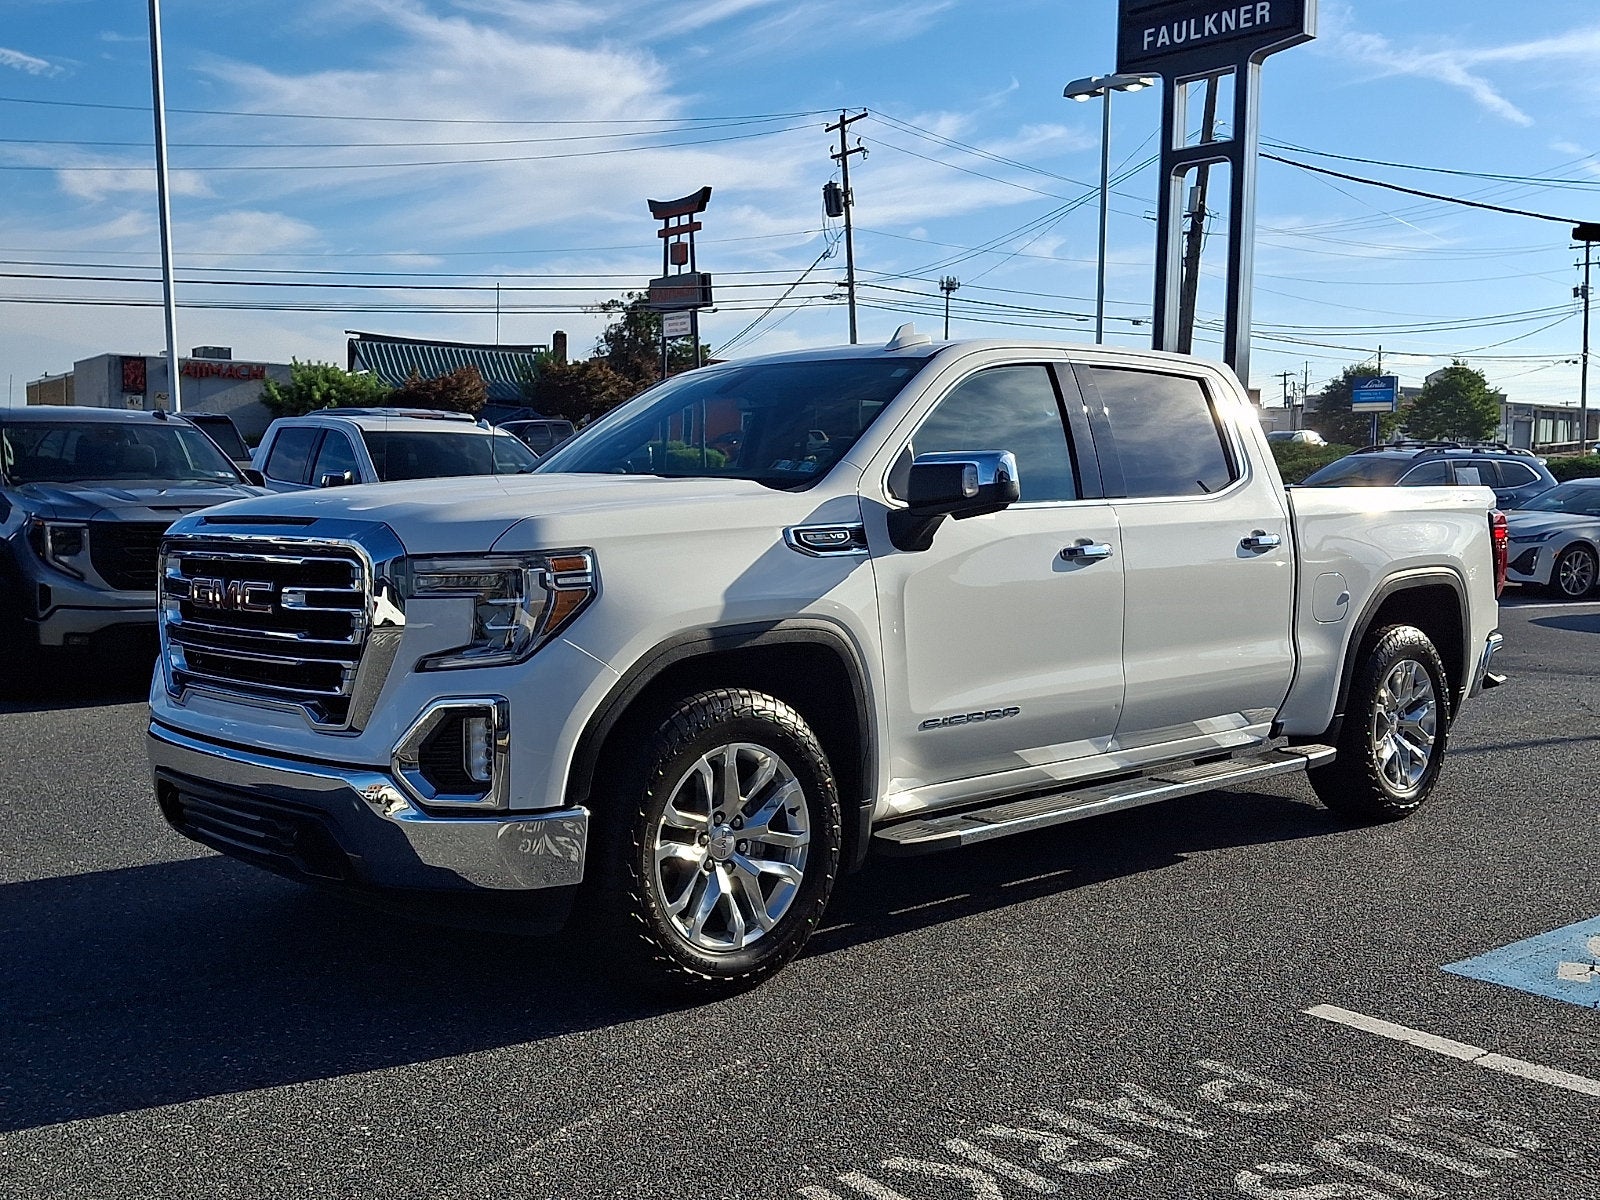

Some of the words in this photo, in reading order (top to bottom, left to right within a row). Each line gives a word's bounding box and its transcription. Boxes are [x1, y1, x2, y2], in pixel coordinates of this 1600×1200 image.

[1142, 2, 1271, 50] FAULKNER
[191, 577, 274, 614] GMC
[918, 706, 1020, 731] SIERRA
